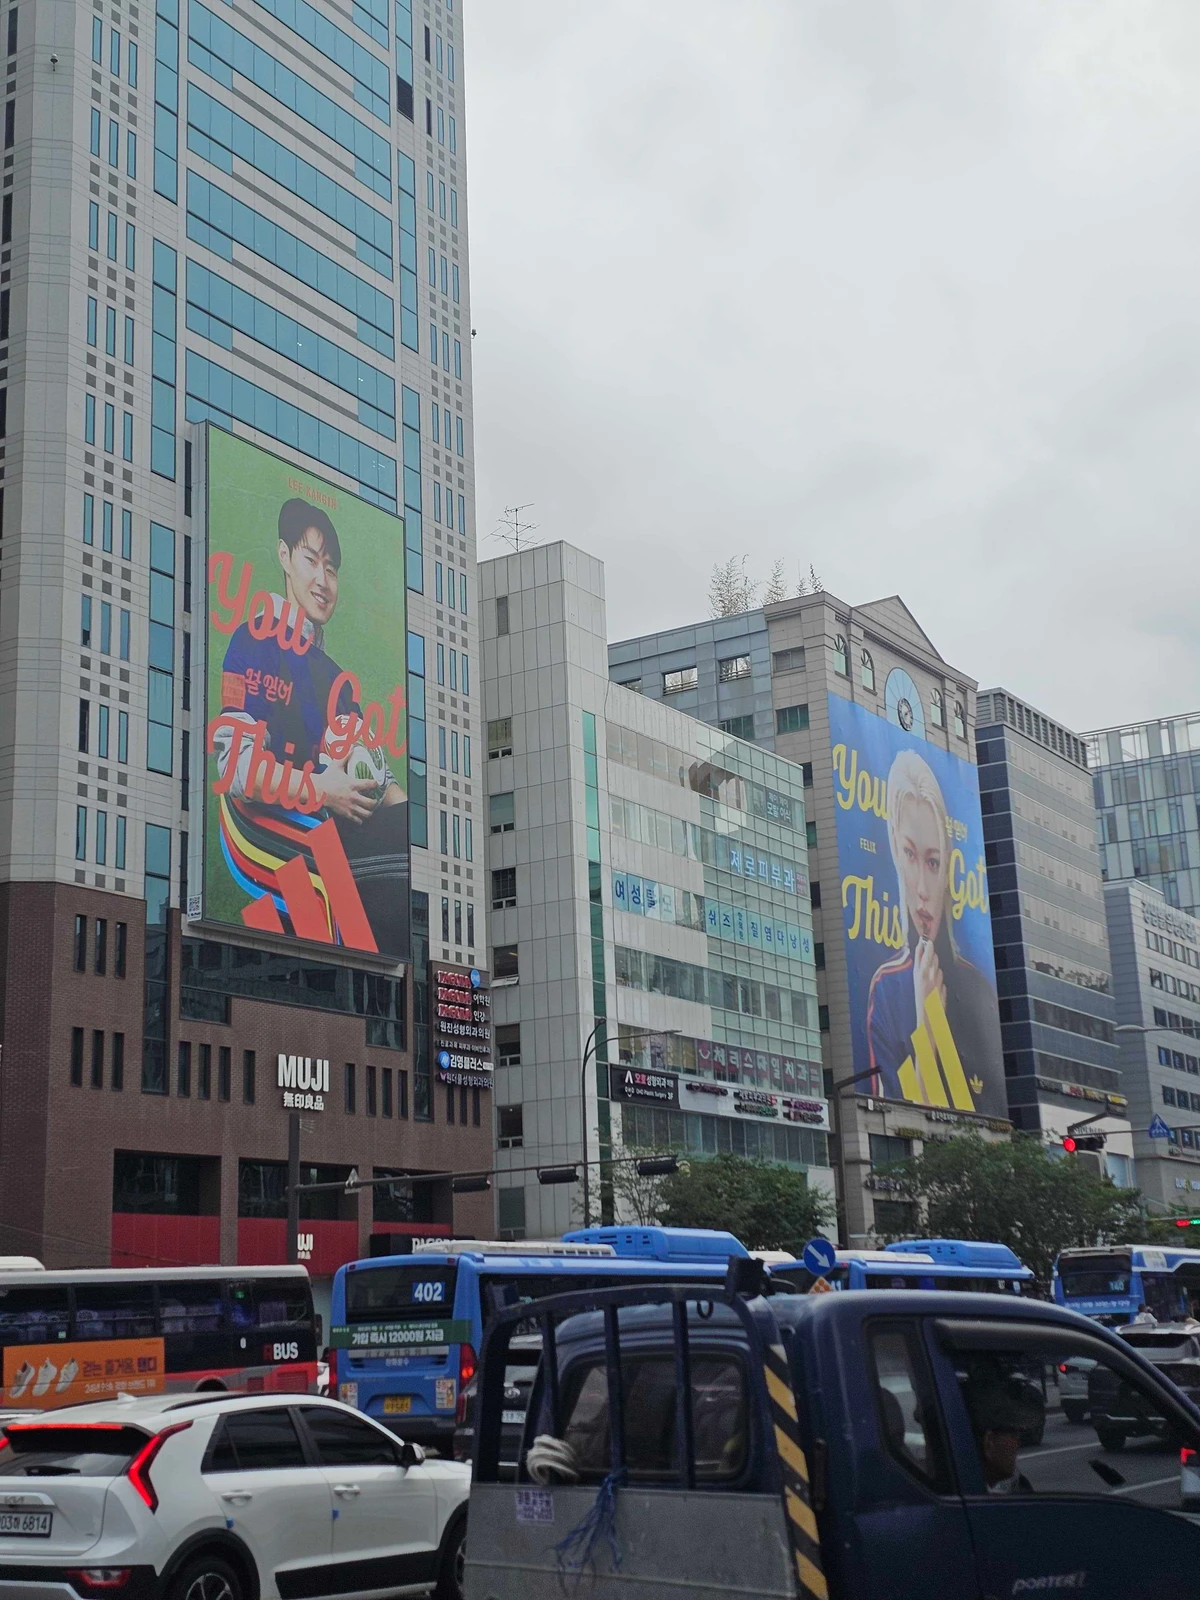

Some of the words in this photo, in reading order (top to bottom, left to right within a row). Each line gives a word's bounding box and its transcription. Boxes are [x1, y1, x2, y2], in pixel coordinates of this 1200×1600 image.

[288, 476, 303, 493] LEE
[305, 485, 337, 510] KANGIN
[208, 550, 315, 656] You
[326, 670, 407, 760] Got
[207, 715, 328, 814] This
[832, 743, 889, 821] You
[859, 837, 877, 854] FELIX
[730, 848, 795, 893] 제로피부과
[948, 848, 989, 921] Got
[614, 879, 673, 914] 여성탈모
[841, 874, 906, 950] This
[440, 1020, 491, 1040] 원진성형외과의원
[277, 1053, 330, 1093] MUJI
[450, 1053, 483, 1071] 김영플러스
[283, 1091, 325, 1111] 無印良品
[297, 1232, 314, 1251] UJI
[413, 1282, 443, 1302] 402
[352, 1332, 369, 1345] 가입
[369, 1331, 387, 1345] 즉시
[388, 1328, 424, 1344] 12000원
[424, 1327, 444, 1342] 지급
[3, 1495, 26, 1504] KIA
[21, 1515, 48, 1532] 6814
